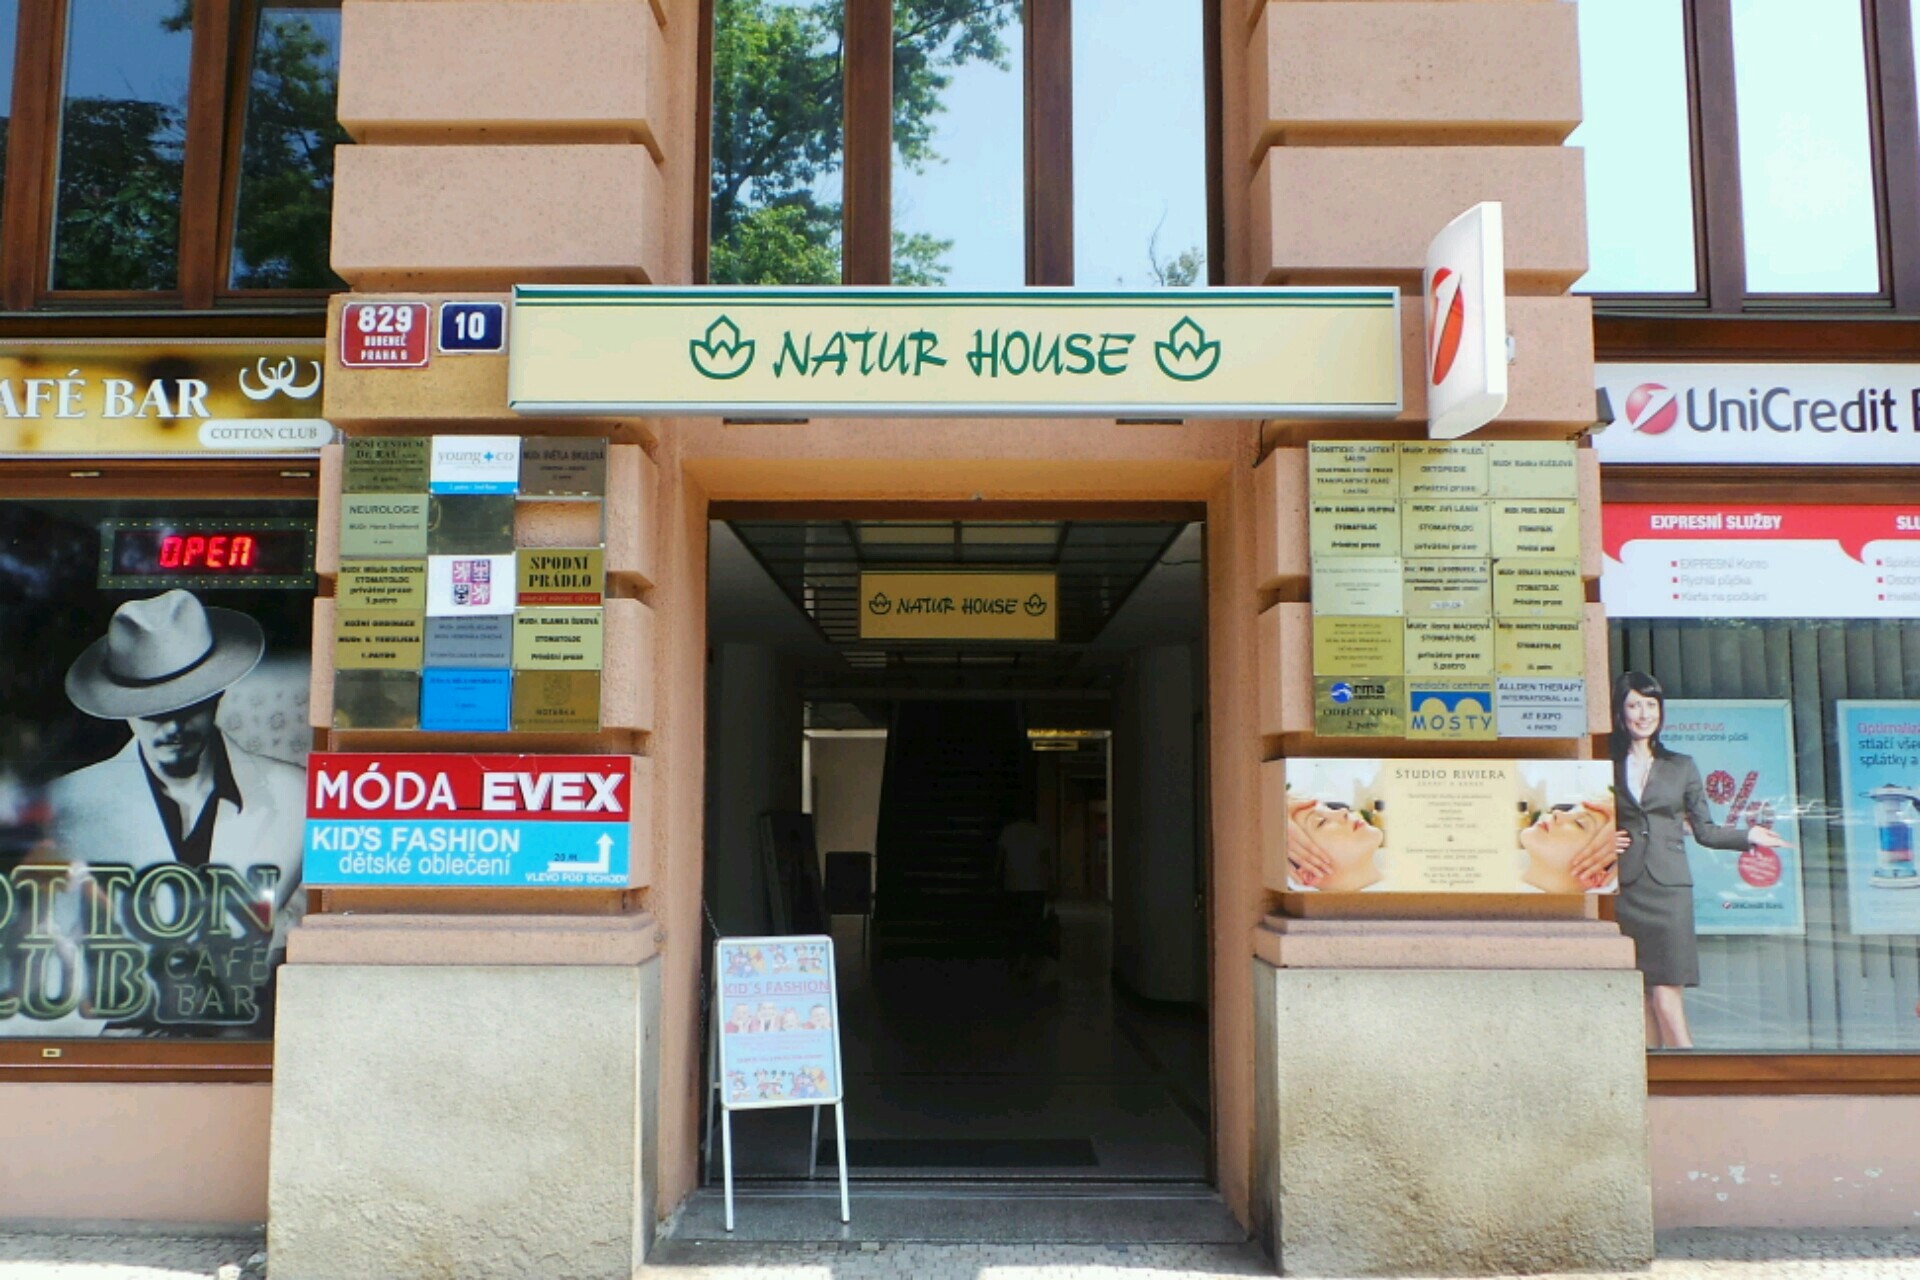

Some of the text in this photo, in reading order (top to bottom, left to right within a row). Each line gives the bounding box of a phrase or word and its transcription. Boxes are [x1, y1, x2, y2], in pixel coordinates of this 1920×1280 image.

[358, 306, 412, 332] 829
[455, 312, 485, 340] 10
[361, 350, 398, 360] PRAHA
[773, 329, 1136, 378] NATUR HOUSE
[101, 379, 211, 418] BAR
[1686, 387, 1898, 433] UniCredit
[211, 428, 317, 439] COTTON CLUB
[438, 451, 481, 463] young
[496, 452, 513, 461] co
[349, 505, 419, 514] NEUROLOGIE
[1651, 512, 1782, 530] EXPRESNÍ SLUŽBY
[531, 554, 590, 570] SPODNÍ
[529, 572, 591, 587] PRÁDLO
[896, 598, 1018, 615] NATUR HOUSE
[1411, 714, 1492, 731] MOSTY
[1395, 769, 1506, 779] STUDIO RIVIERA
[316, 762, 624, 812] MÓDA EVEX
[312, 826, 520, 852] KID'S FASHION
[339, 852, 511, 876] dětské oblečení
[525, 872, 559, 882] VLEVO
[563, 873, 583, 882] POD
[165, 940, 270, 982] CAFÉ
[766, 979, 832, 995] FASHION
[174, 984, 256, 1016] BAR
